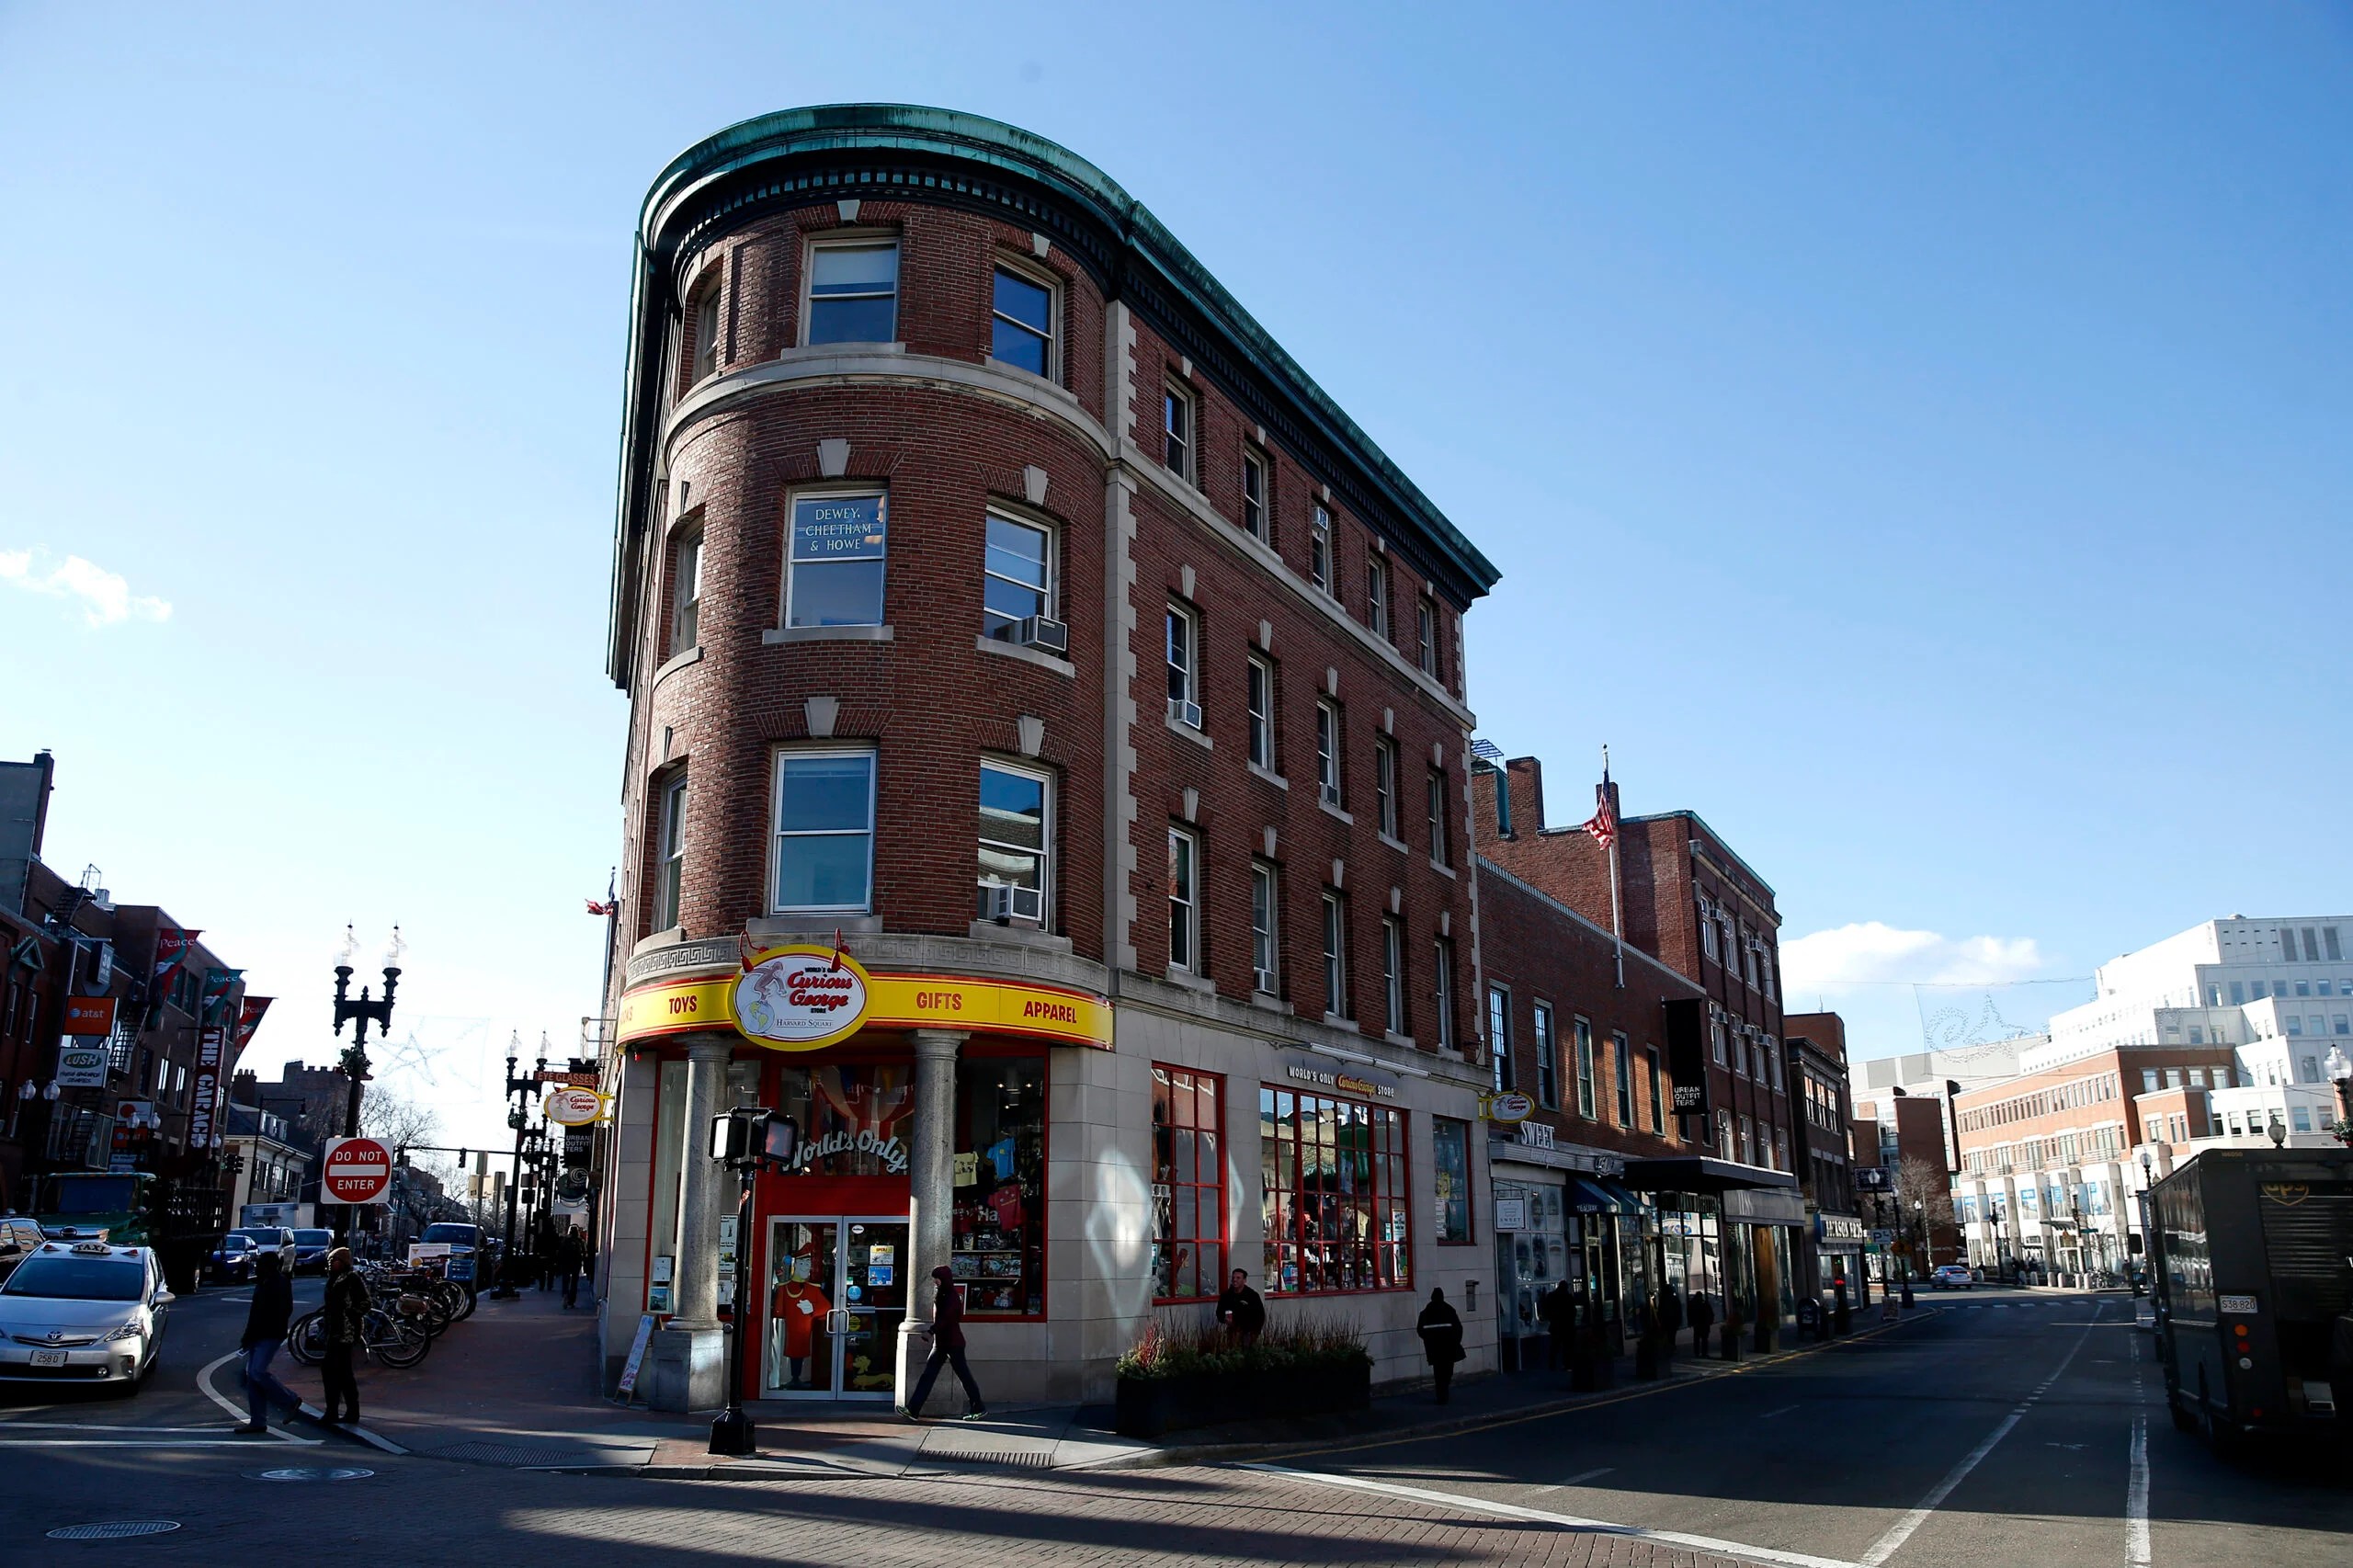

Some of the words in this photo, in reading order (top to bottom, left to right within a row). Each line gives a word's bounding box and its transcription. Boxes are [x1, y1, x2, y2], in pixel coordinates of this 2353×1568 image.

[815, 507, 860, 520] DEWEY,
[805, 523, 871, 537] CHEETHAM
[810, 540, 819, 551] &
[826, 539, 860, 551] HOWE
[160, 938, 195, 949] Peace
[208, 975, 238, 984] Peace
[787, 971, 853, 989] Curious
[669, 995, 697, 1014] TOYS
[789, 989, 848, 1011] George
[916, 992, 962, 1010] GIFTS
[81, 1009, 105, 1018] at&t
[1023, 1001, 1077, 1024] APPAREL
[200, 1030, 220, 1066] THE
[65, 1054, 99, 1065] LUSH
[538, 1072, 553, 1080] EYE
[555, 1074, 596, 1084] GLASSES
[1289, 1066, 1316, 1082] WORLD'S
[1337, 1074, 1358, 1090] Curious
[1358, 1079, 1376, 1096] George
[1520, 1120, 1555, 1149] SWEET
[335, 1152, 352, 1161] DO
[358, 1152, 382, 1161] NOT
[858, 1130, 908, 1173] Only
[337, 1180, 375, 1189] ENTER
[75, 1244, 107, 1253] TAXI
